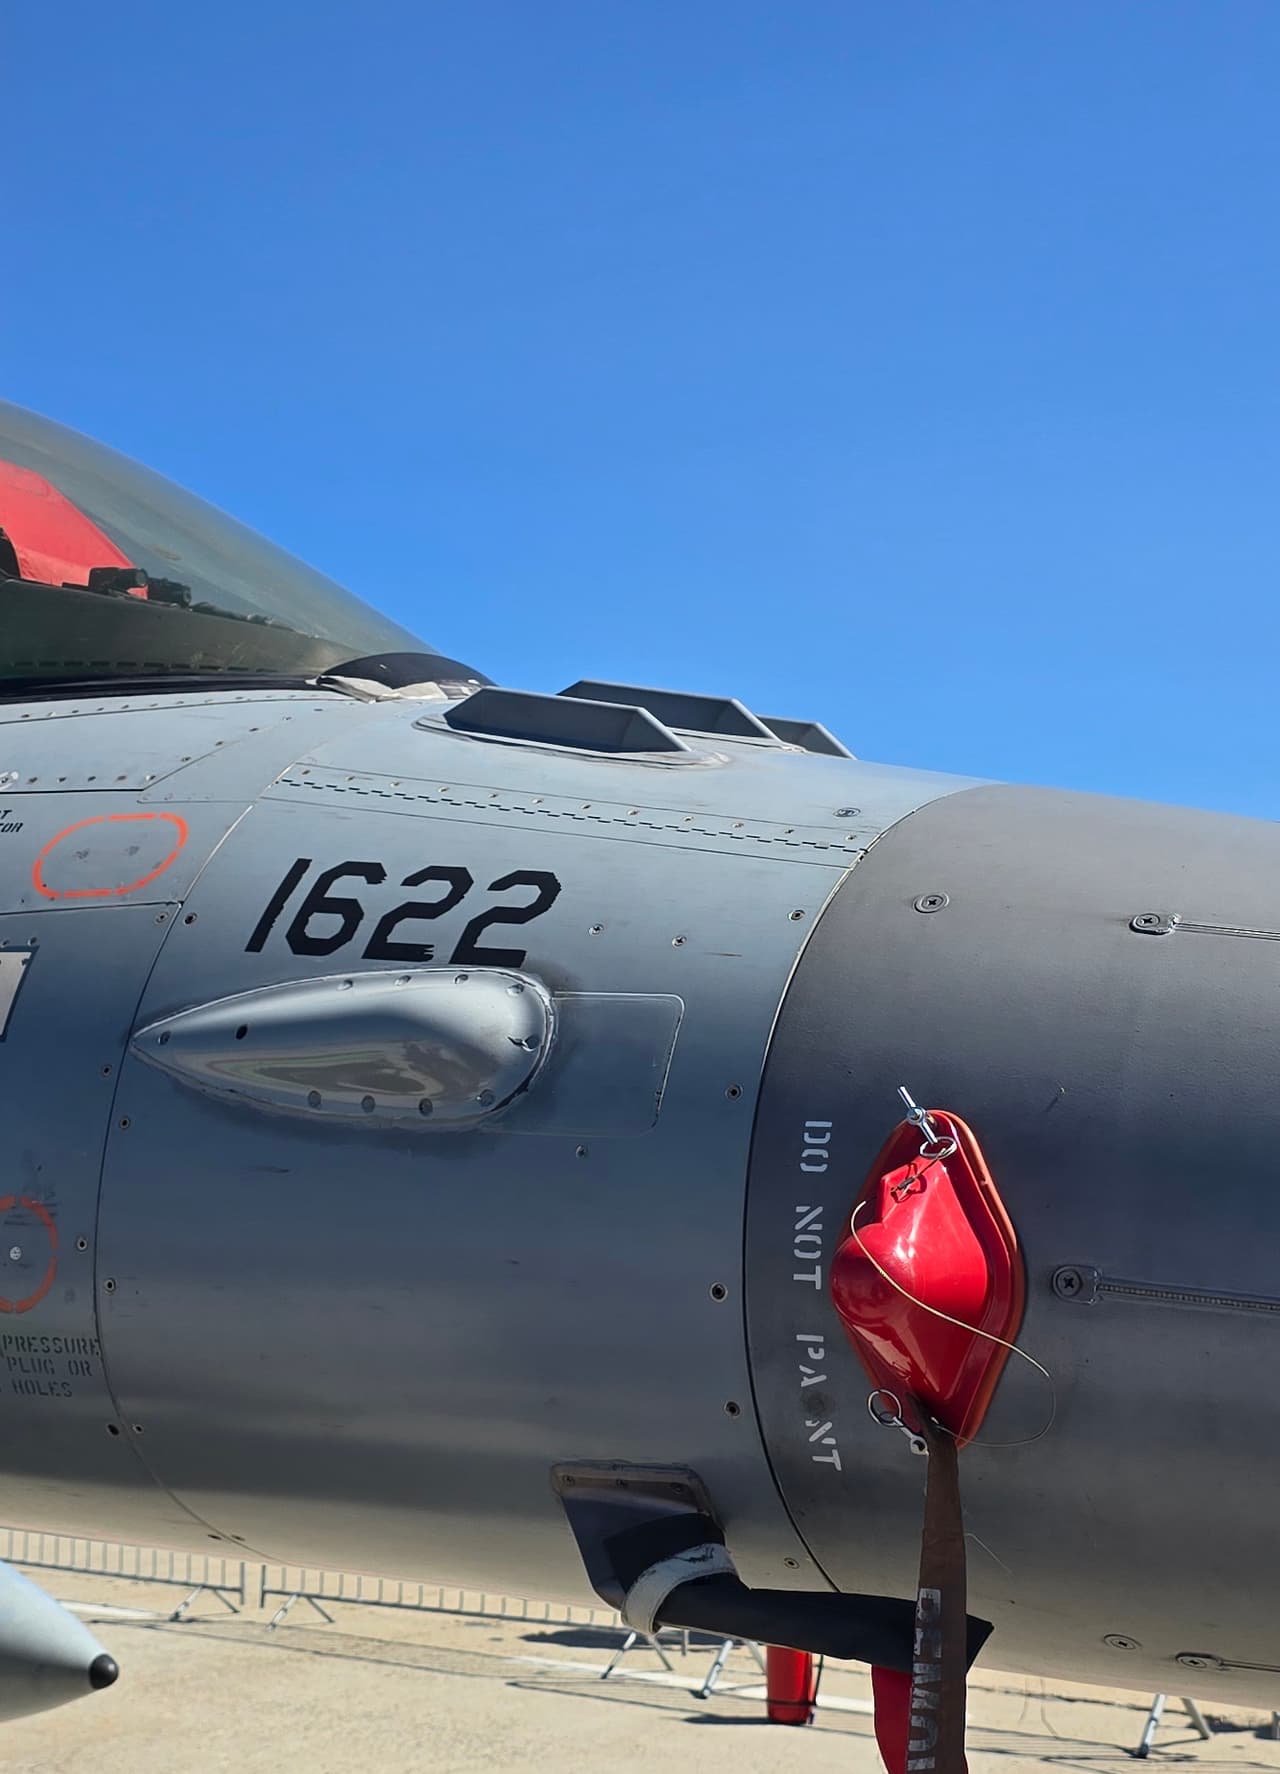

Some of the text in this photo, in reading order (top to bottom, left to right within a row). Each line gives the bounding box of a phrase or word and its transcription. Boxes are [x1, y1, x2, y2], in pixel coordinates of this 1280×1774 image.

[244, 858, 562, 968] 1622
[793, 1121, 842, 1471] DO NOT PANT
[1, 1334, 100, 1356] PRESSURE
[7, 1356, 55, 1375] PLUG
[68, 1360, 93, 1377] OR
[12, 1378, 73, 1398] HOLES
